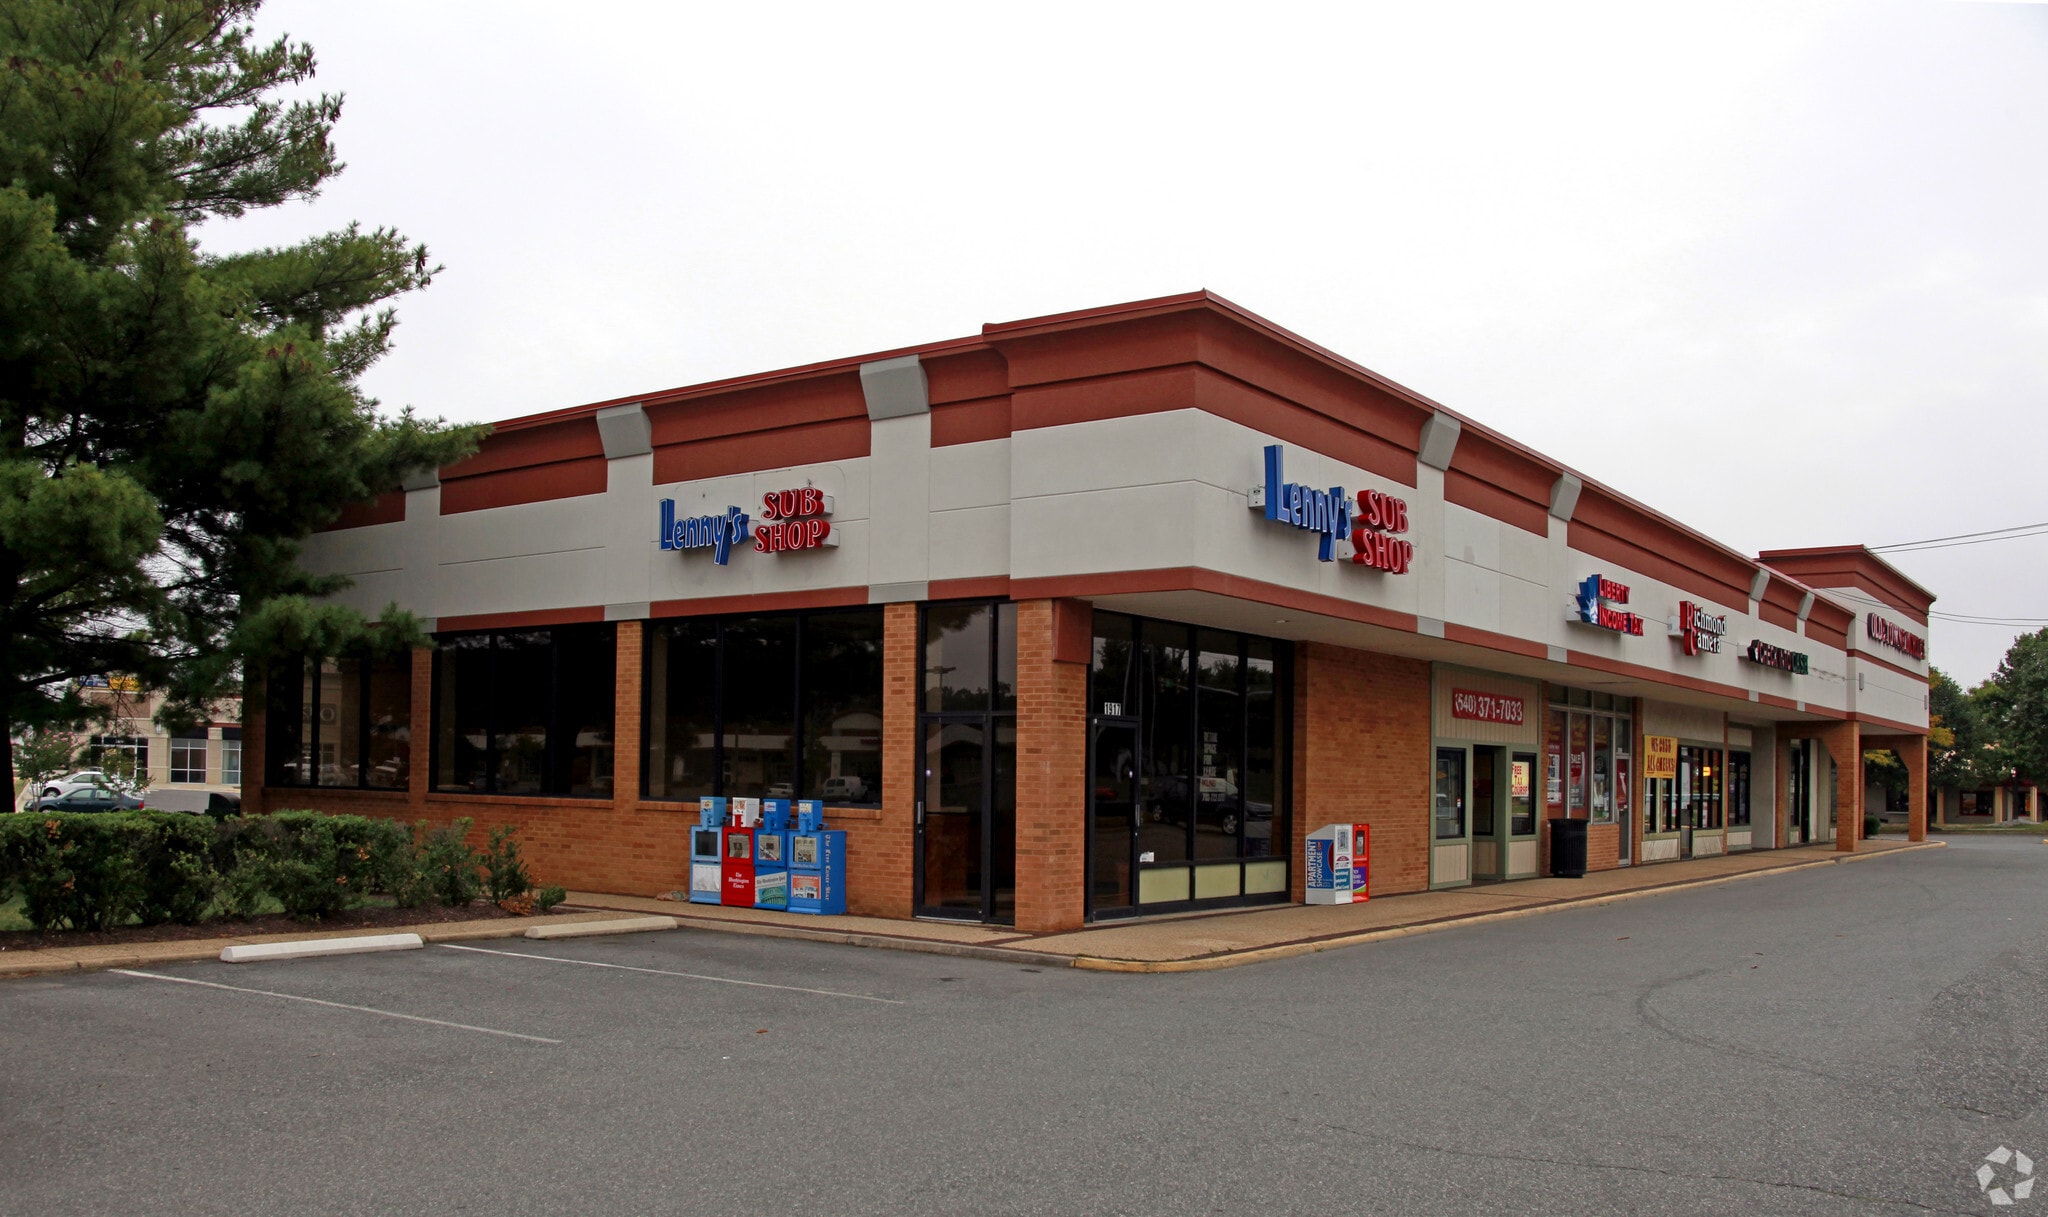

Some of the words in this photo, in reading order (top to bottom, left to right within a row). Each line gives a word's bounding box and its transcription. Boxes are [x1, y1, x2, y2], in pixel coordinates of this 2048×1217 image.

[762, 487, 825, 520] SUB
[1264, 445, 1352, 562] Lenny's
[1357, 489, 1409, 534] SUB
[659, 498, 749, 565] Lenny's
[754, 519, 830, 553] SHOP
[1352, 528, 1413, 574] SHOP
[1600, 579, 1630, 604] LIBERTY
[1679, 601, 1726, 636] Richmond
[1684, 629, 1720, 656] Camera
[1104, 702, 1121, 715] 1917
[1455, 693, 1476, 714] (540)
[1478, 696, 1523, 721] 371-7033
[1307, 841, 1316, 887] APARTMENT
